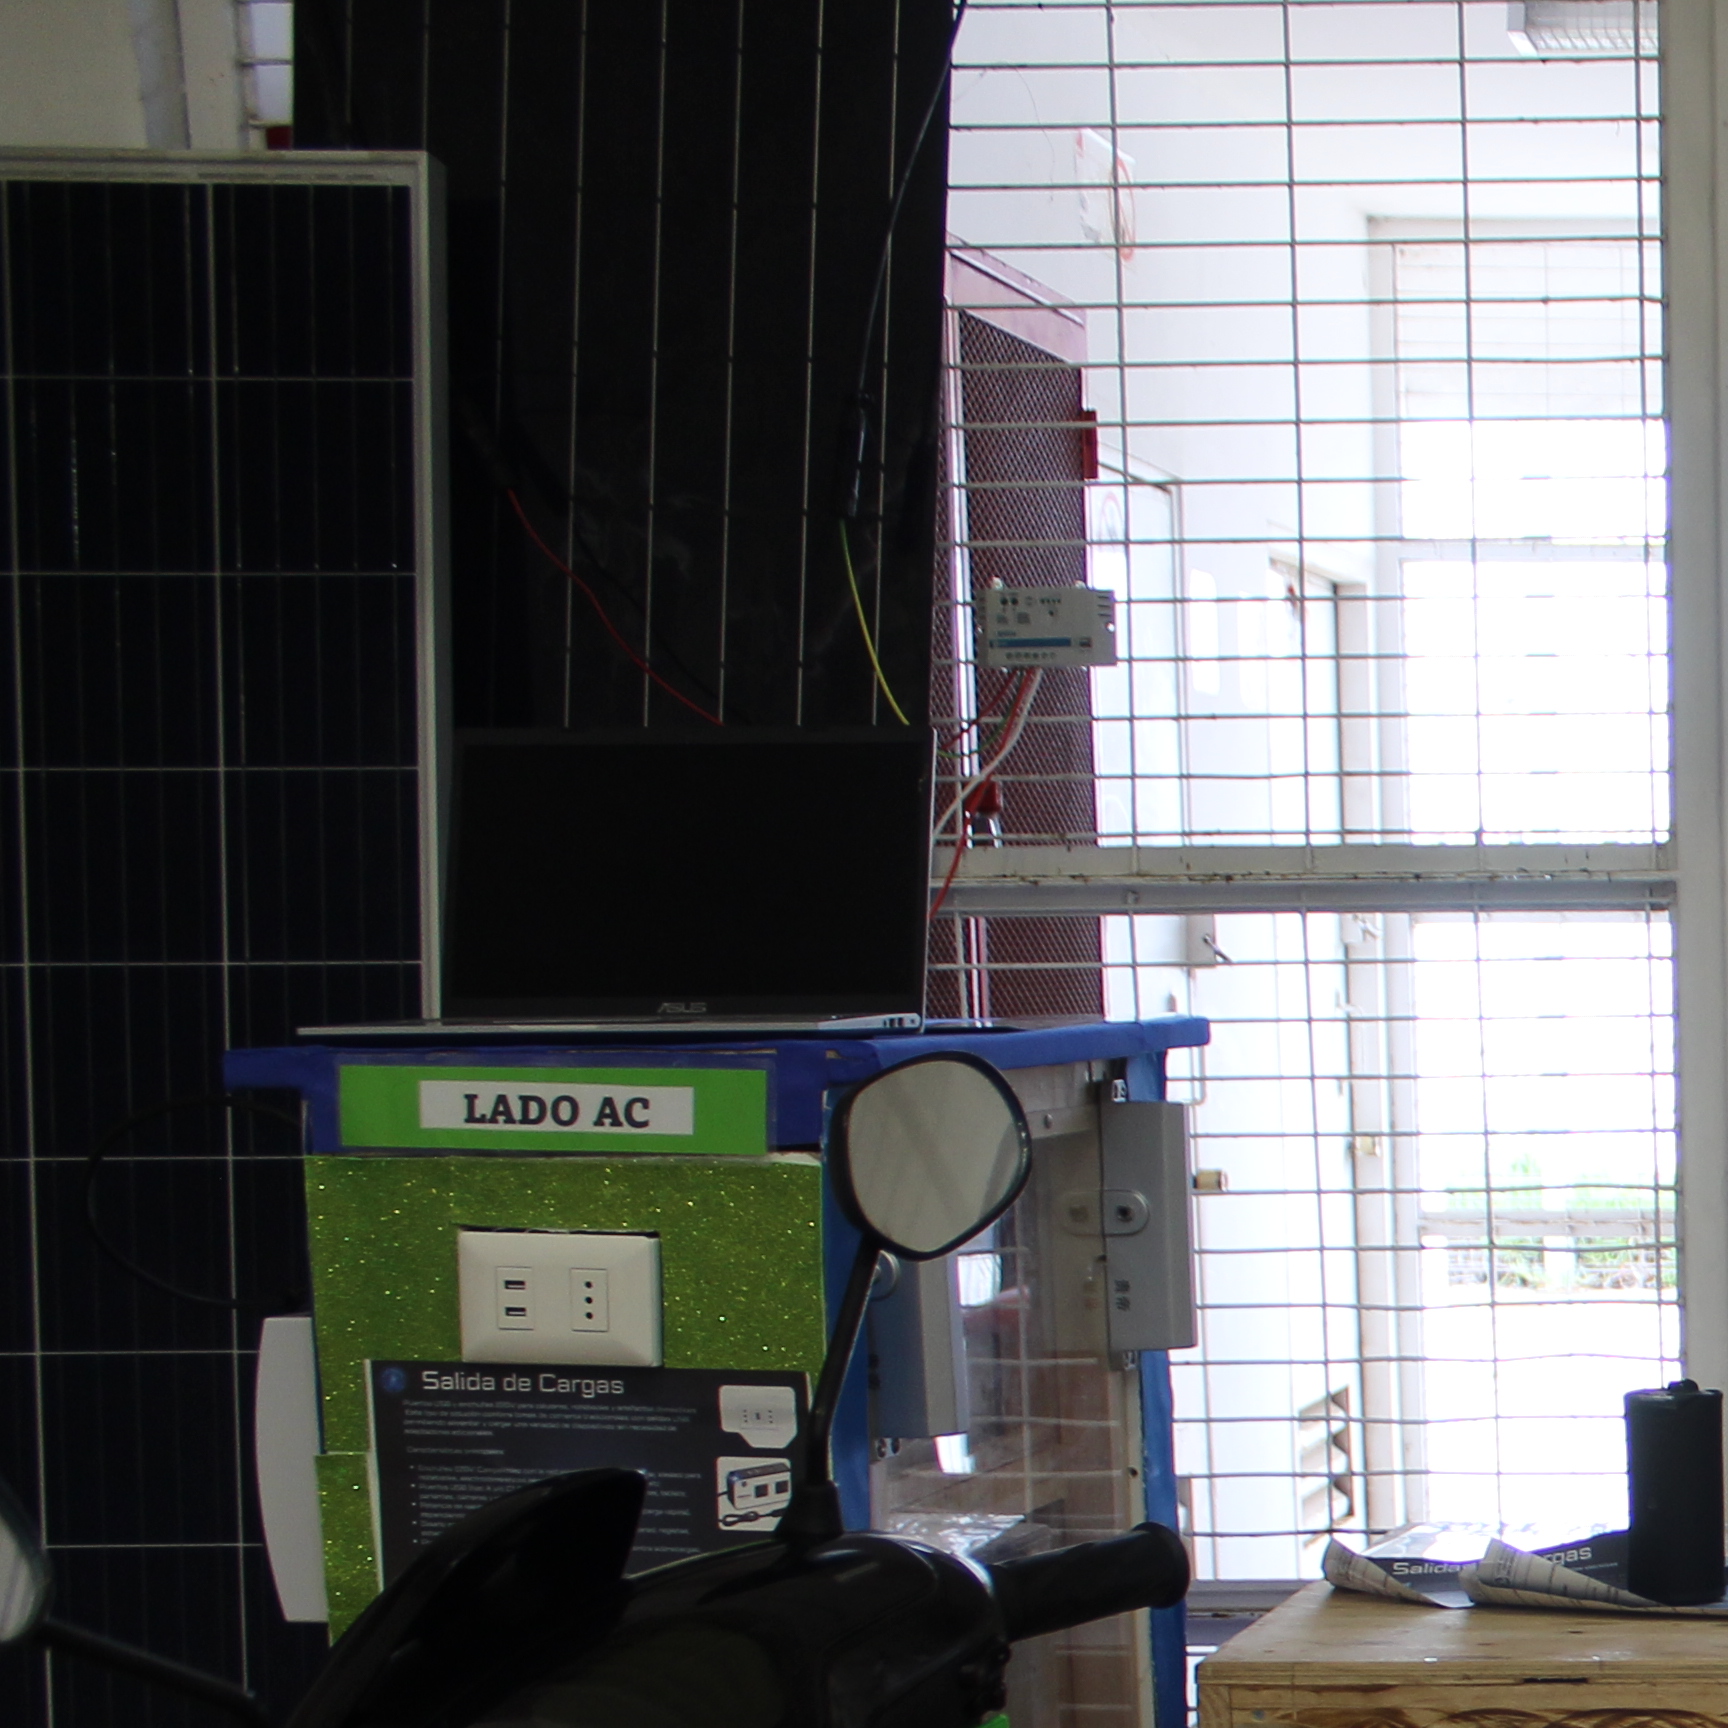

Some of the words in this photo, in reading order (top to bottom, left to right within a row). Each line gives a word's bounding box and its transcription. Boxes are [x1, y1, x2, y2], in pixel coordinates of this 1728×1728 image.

[658, 1002, 707, 1013] ASUS
[463, 1093, 580, 1128] LADO
[593, 1096, 651, 1129] AC
[421, 1370, 496, 1392] Salida
[503, 1373, 532, 1393] de
[539, 1373, 625, 1399] Cargas
